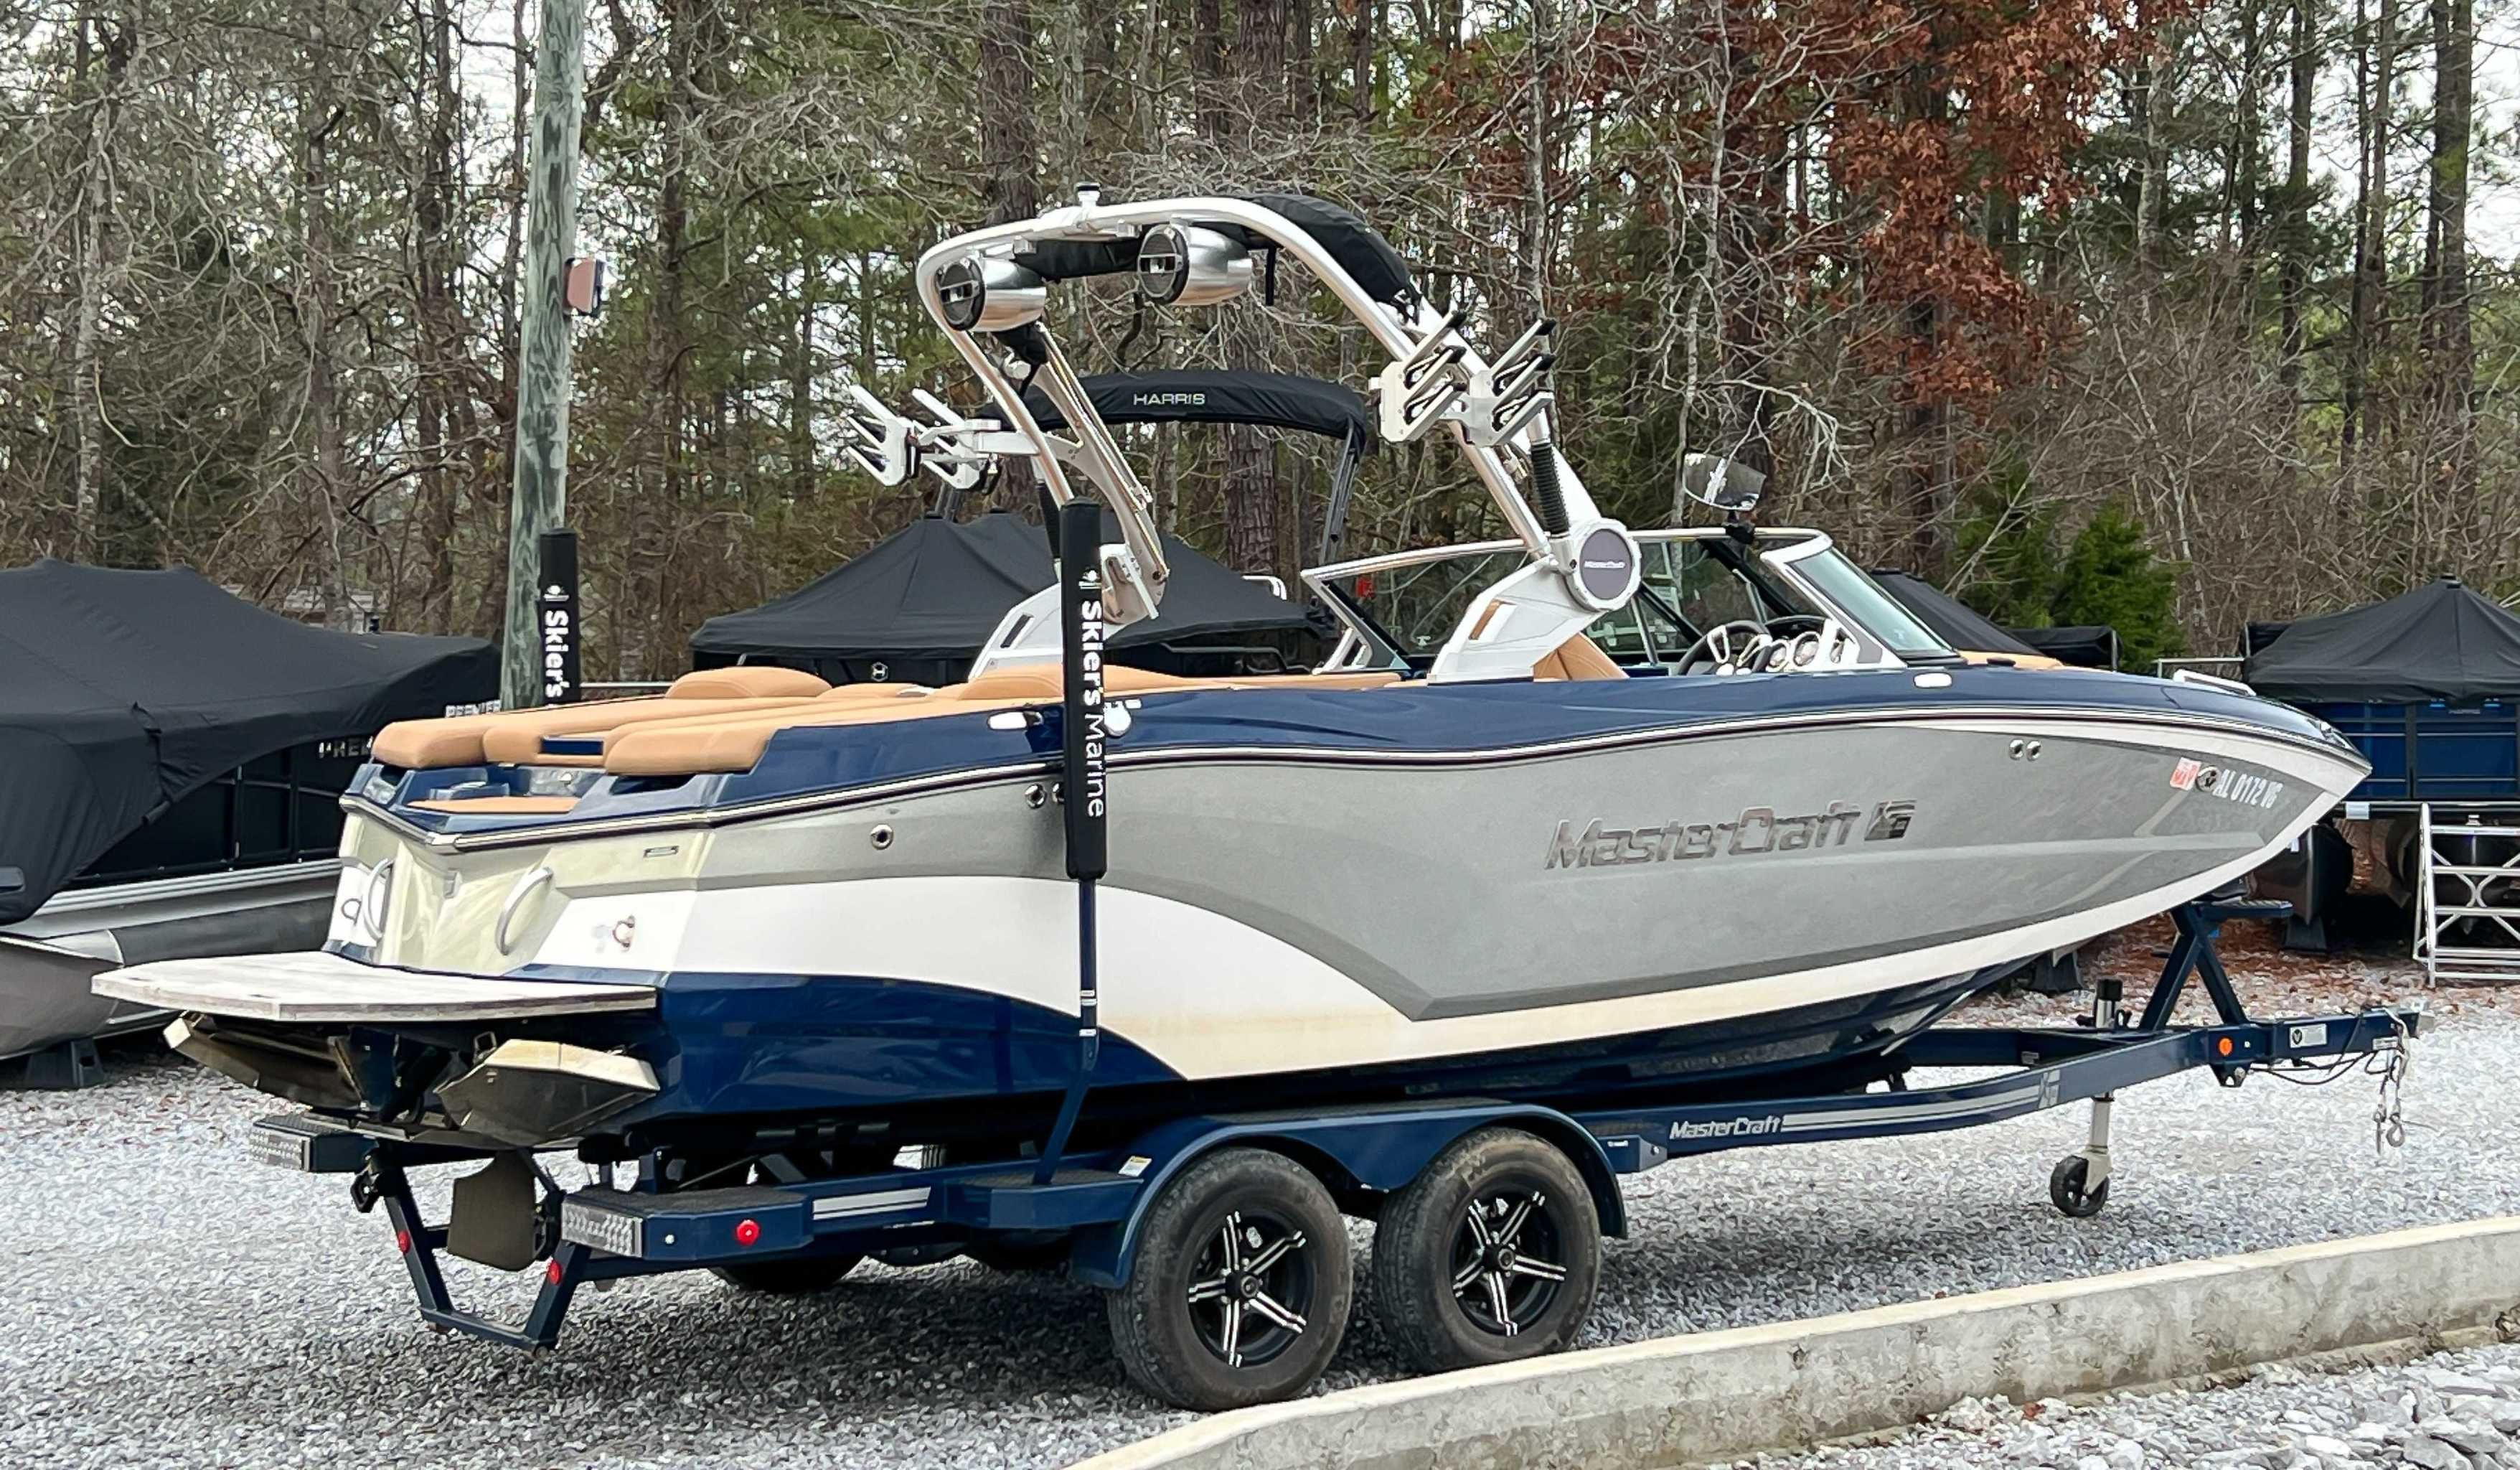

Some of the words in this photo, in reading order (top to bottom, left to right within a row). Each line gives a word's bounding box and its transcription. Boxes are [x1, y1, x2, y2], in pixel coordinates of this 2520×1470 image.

[1133, 393, 1205, 406] HARRIS
[544, 610, 570, 698] Skier's
[1081, 600, 1104, 706] Skier's
[1084, 713, 1106, 818] Marine
[1544, 799, 1862, 870] MasterCraft
[1669, 1115, 1782, 1140] MasterCraft
